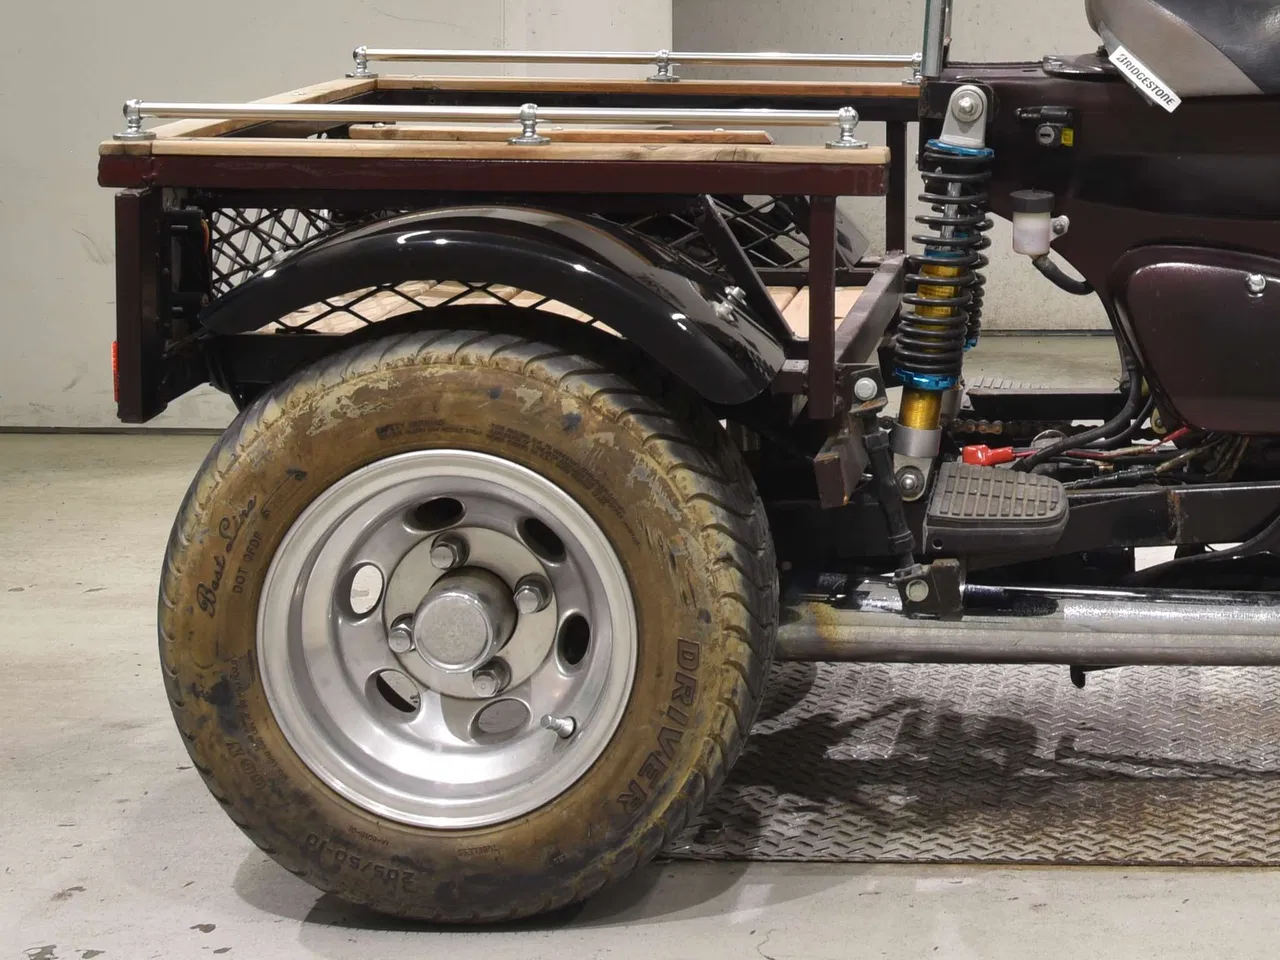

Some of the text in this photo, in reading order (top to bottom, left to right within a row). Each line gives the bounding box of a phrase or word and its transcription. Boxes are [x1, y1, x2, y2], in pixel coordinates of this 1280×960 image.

[1116, 53, 1176, 106] BRIDGESTONE
[232, 566, 249, 594] DOT
[616, 636, 701, 815] DRIVER
